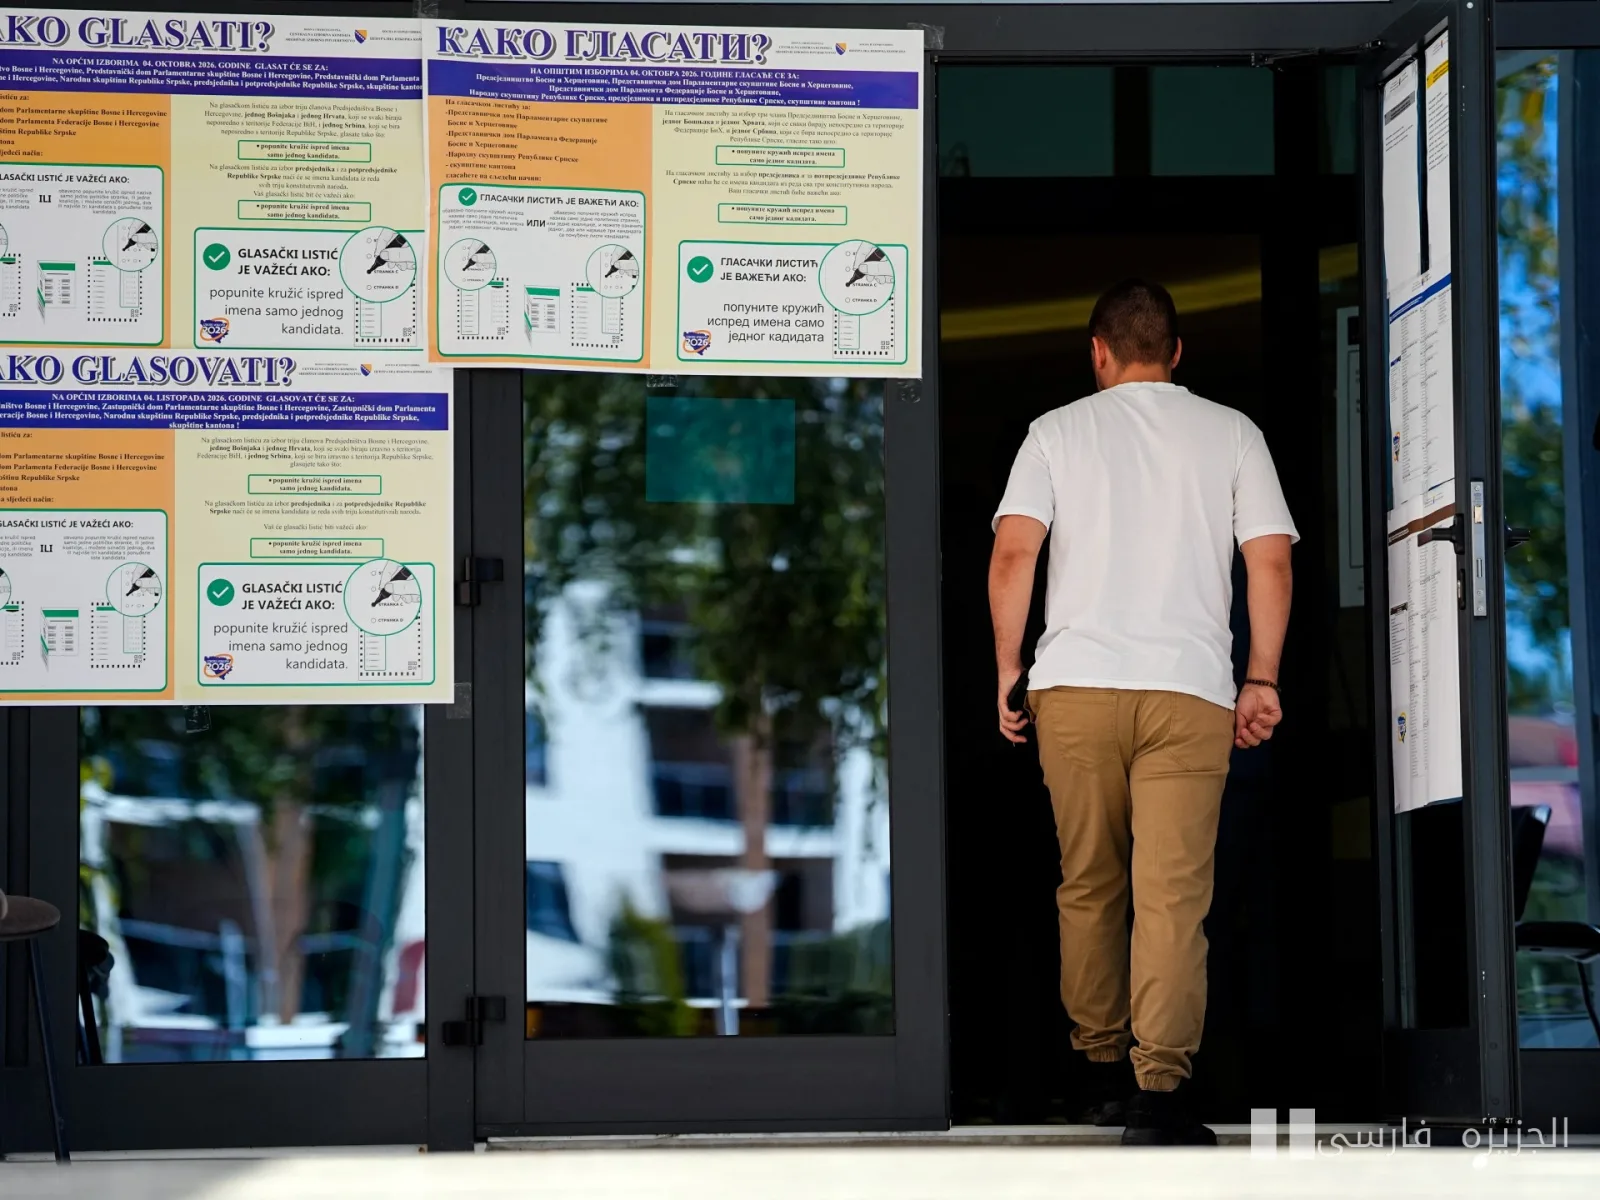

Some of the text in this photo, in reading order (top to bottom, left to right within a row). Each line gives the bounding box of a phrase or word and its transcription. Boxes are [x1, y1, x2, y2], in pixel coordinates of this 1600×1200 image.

[78, 17, 276, 52] GLASATI?
[436, 26, 556, 60] КАКО
[564, 29, 772, 65] ГЛАСАТИ?
[66, 57, 95, 65] OPĆIM
[96, 59, 139, 67] IZBORIMA
[155, 60, 196, 68] OKTOBRA
[198, 61, 216, 69] 2026.
[254, 62, 287, 70] GLASAT
[289, 62, 301, 71] ĆE
[11, 65, 33, 73] Bosne
[39, 66, 85, 75] Hercegovine,
[86, 67, 135, 75] Predstavnički
[153, 69, 205, 77] Parlamentarne
[207, 70, 240, 79] skupštine
[268, 72, 313, 81] Hercegovine,
[314, 73, 362, 81] Predstavnički
[380, 74, 420, 82] Parlamenta
[584, 68, 629, 76] ИЗБОРИМА
[641, 69, 680, 77] ОКТОБРА
[700, 71, 733, 79] ГОДИНЕ
[735, 71, 773, 79] ГЛАСАЋЕ
[285, 152, 306, 160] jednog
[37, 173, 63, 182] LISTIĆ
[76, 174, 107, 183] VAŽEĆI
[109, 176, 129, 184] AKO:
[39, 194, 52, 203] ILI
[480, 194, 639, 208] ГЛАСАЧКИ ЛИСТИЋ ЈЕ ВАЖЕЋИ АКО:
[526, 219, 546, 227] ИЛИ
[238, 246, 338, 260] GLASAČKI LISTIĆ
[720, 257, 818, 268] ГЛАСАЧКИ ЛИСТИЋ
[238, 263, 330, 276] JE VAŽEĆI AKO:
[720, 272, 806, 282] ЈЕ ВАЖЕЋИ АКО:
[209, 287, 344, 301] popunite kružić ispred
[224, 304, 344, 320] imena samo jednog
[723, 303, 825, 315] попуните кружић
[281, 323, 344, 335] kandidata.
[707, 318, 825, 328] испред имена само
[728, 331, 825, 343] једног кадидата
[72, 355, 297, 387] GLASOVATI?
[52, 393, 64, 401] NA
[66, 393, 96, 401] OPĆIM
[156, 394, 205, 402] LISTOPADA
[314, 394, 327, 402] ĆE
[340, 395, 355, 403] ZA:
[24, 402, 47, 410] Bosne
[53, 403, 100, 411] Hercegovine,
[102, 403, 146, 411] Zastupnički
[165, 403, 219, 411] Parlamentarne
[221, 404, 255, 412] skupštine
[284, 404, 331, 413] Hercegovine,
[332, 404, 376, 413] Zastupnički
[65, 453, 97, 461] skupštine
[124, 453, 165, 461] Hercegovine
[40, 519, 67, 528] LISTIĆ
[68, 520, 78, 528] JE
[80, 519, 111, 528] VAŽEĆI
[113, 520, 133, 528] AKO:
[40, 544, 53, 553] ILI
[242, 581, 343, 594] GLASAČKI LISTIĆ
[241, 597, 335, 610] JE VAŽEĆI AKO:
[213, 622, 348, 636] popunite kružić ispred
[228, 641, 348, 655] imena samo jednog
[285, 658, 348, 669] kandidata.
